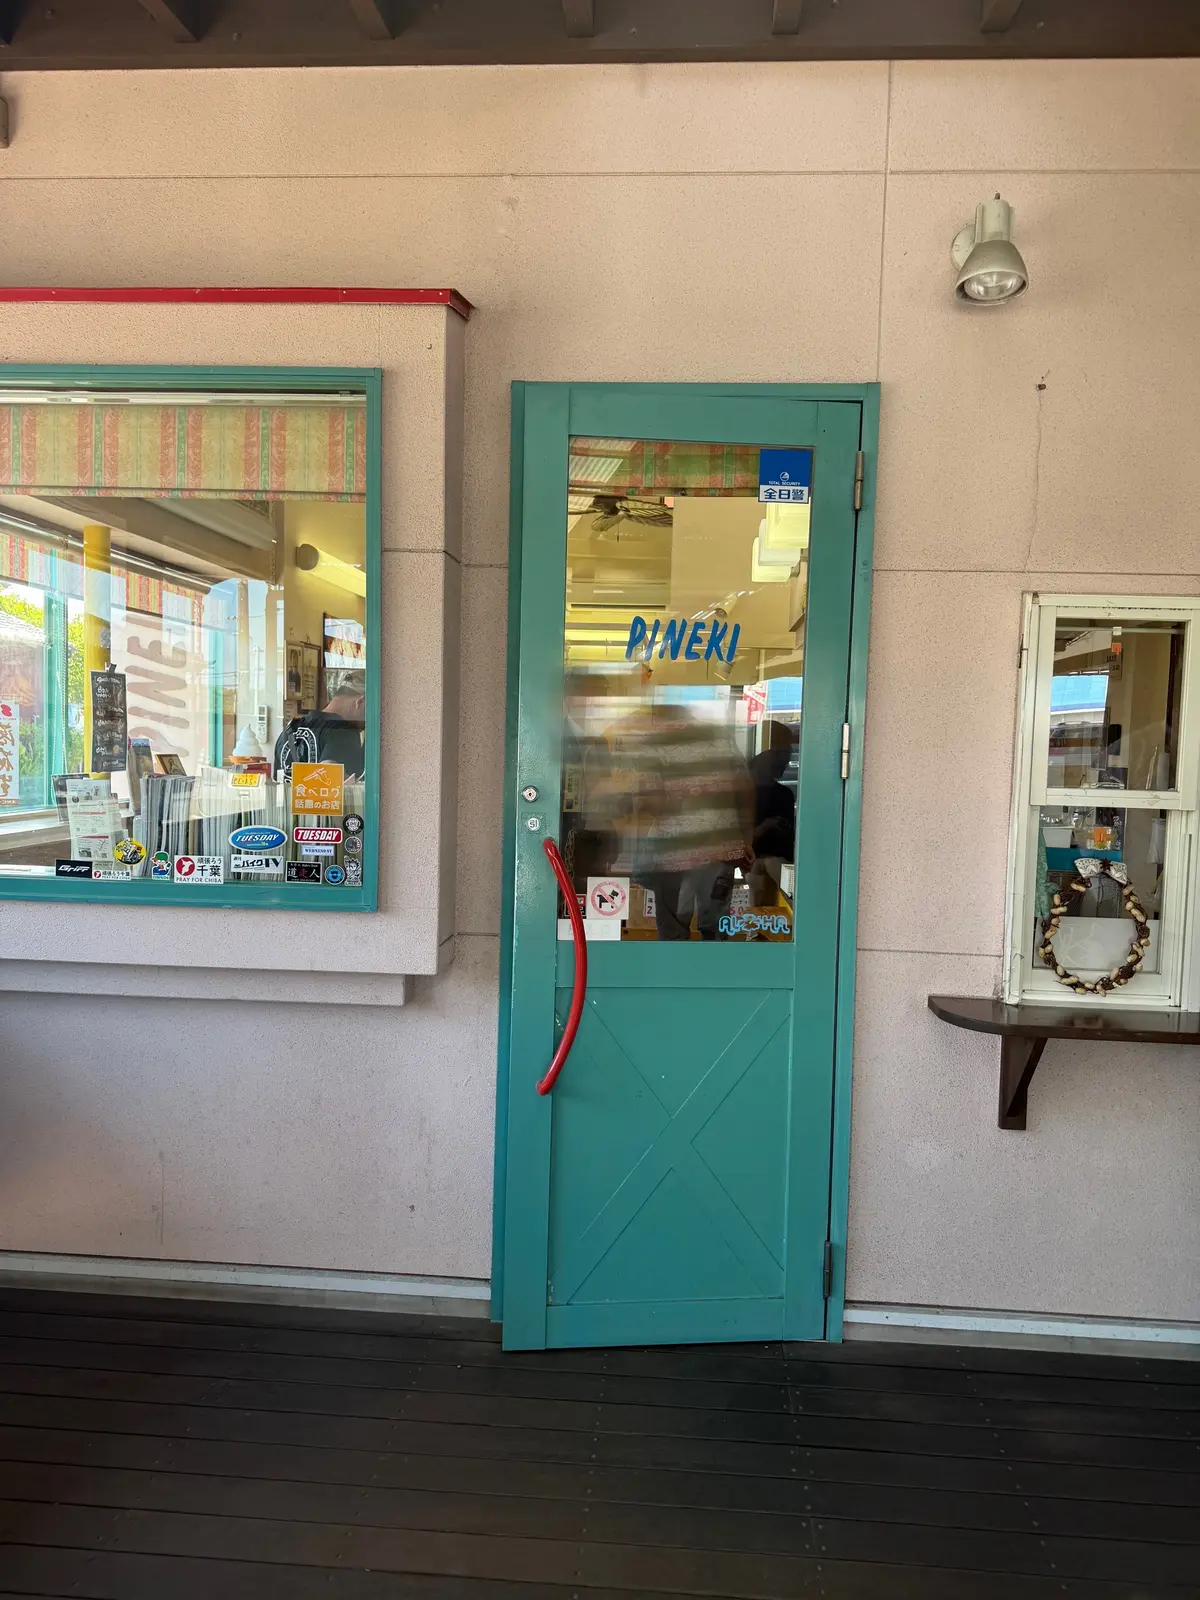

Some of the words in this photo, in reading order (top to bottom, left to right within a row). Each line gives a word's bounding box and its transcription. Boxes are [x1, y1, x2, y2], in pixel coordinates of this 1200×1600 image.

[763, 487, 805, 501] 全日警
[624, 615, 742, 664] PINEKI
[295, 783, 341, 798] 食べログ
[294, 799, 340, 810] 話題のお店
[235, 833, 280, 842] TUESDAY
[297, 829, 339, 841] TUESDAY
[197, 857, 222, 865] 頑張ろう
[196, 865, 221, 877] 千葉
